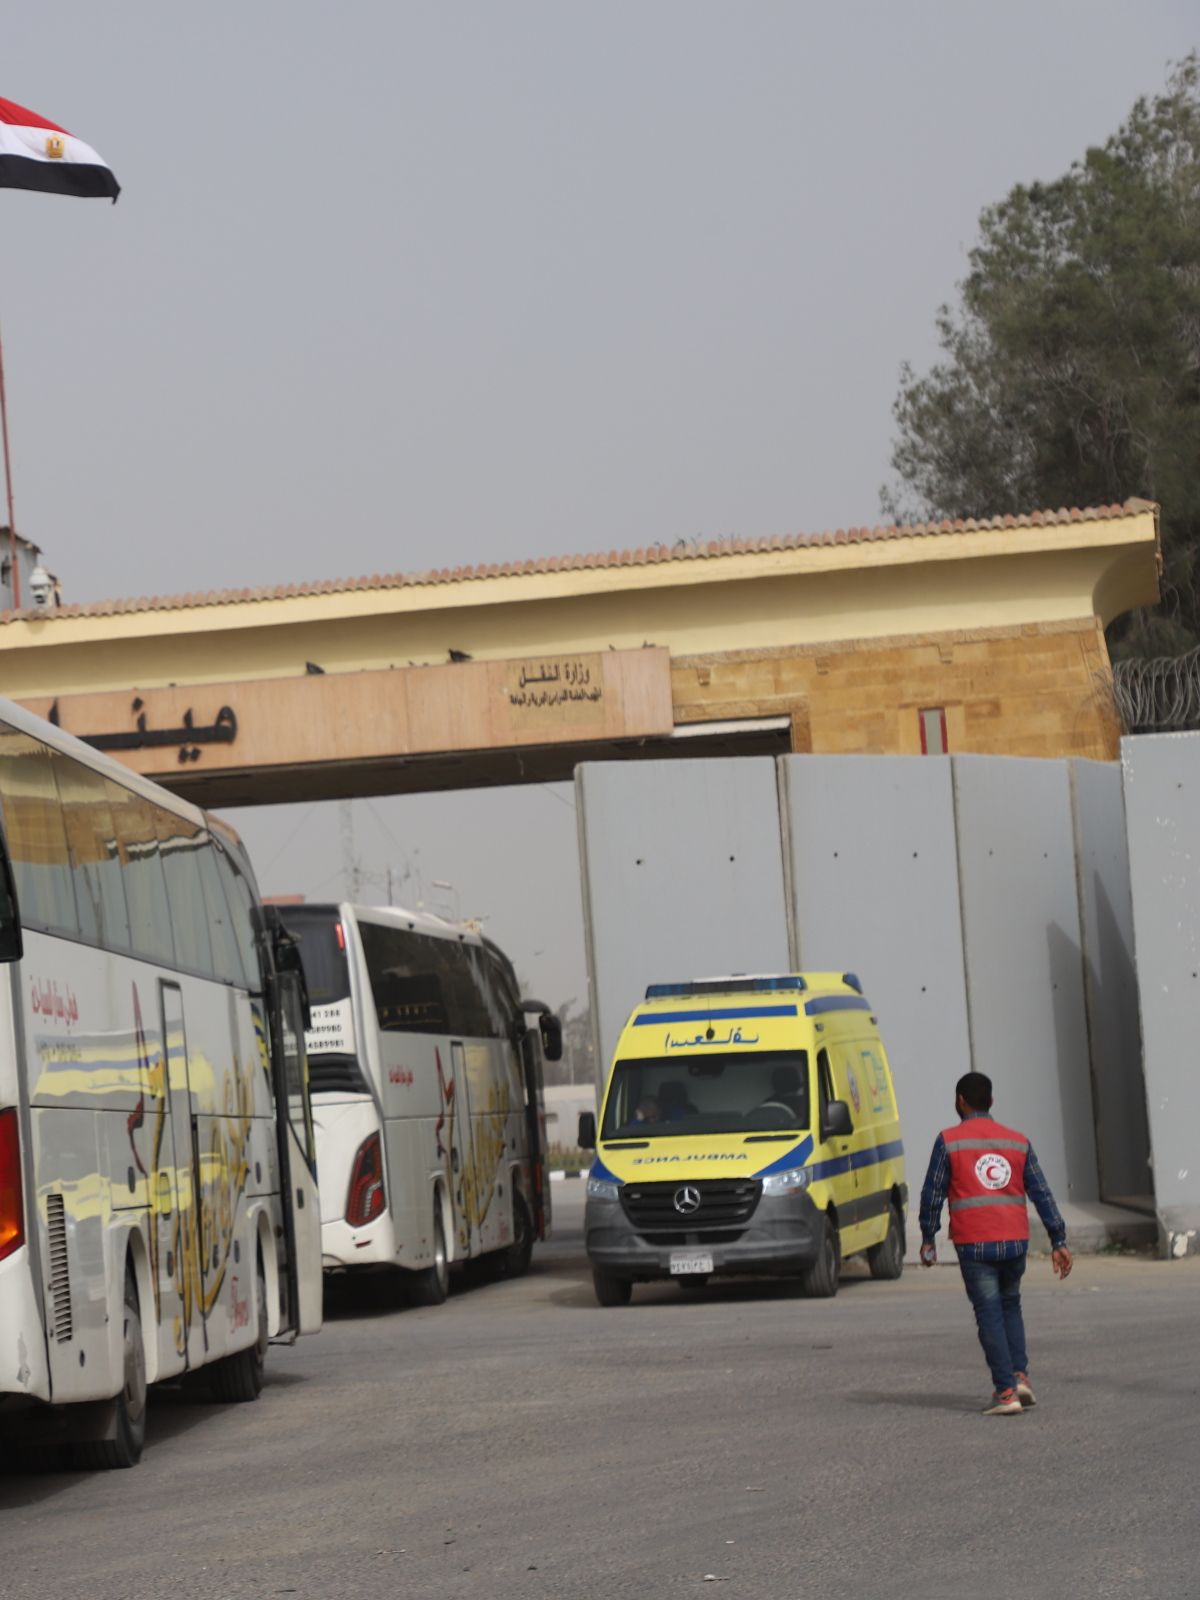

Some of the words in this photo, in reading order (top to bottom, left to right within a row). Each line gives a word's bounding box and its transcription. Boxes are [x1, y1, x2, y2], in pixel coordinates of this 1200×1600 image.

[519, 663, 560, 688] النقل
[564, 662, 590, 686] وزارة
[48, 697, 237, 764] مينا
